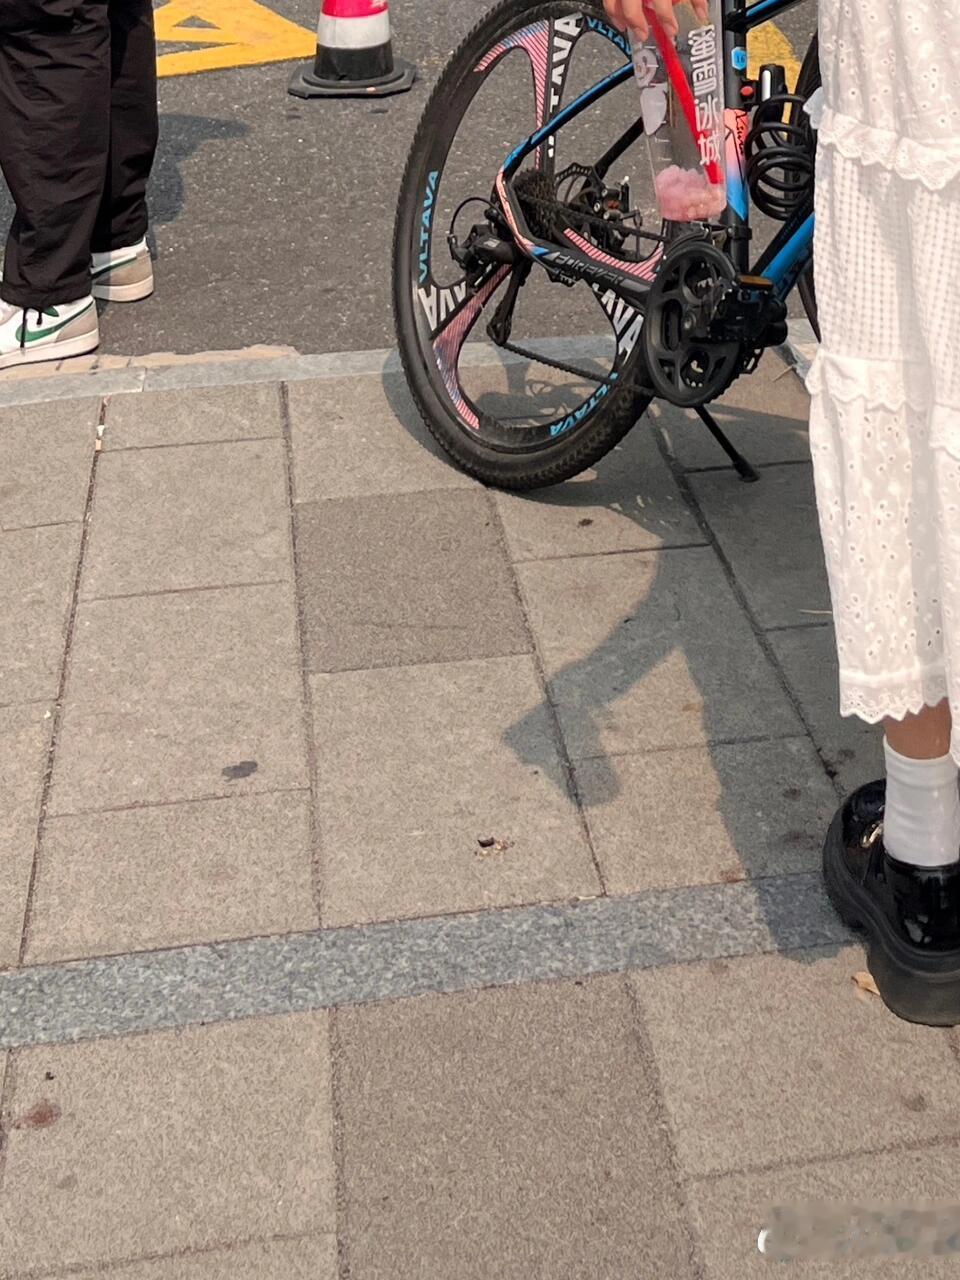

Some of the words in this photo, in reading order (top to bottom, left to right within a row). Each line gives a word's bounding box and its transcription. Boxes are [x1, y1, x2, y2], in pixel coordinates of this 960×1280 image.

[687, 23, 721, 167] 蜜雪冰城
[418, 170, 440, 284] VLTAVA
